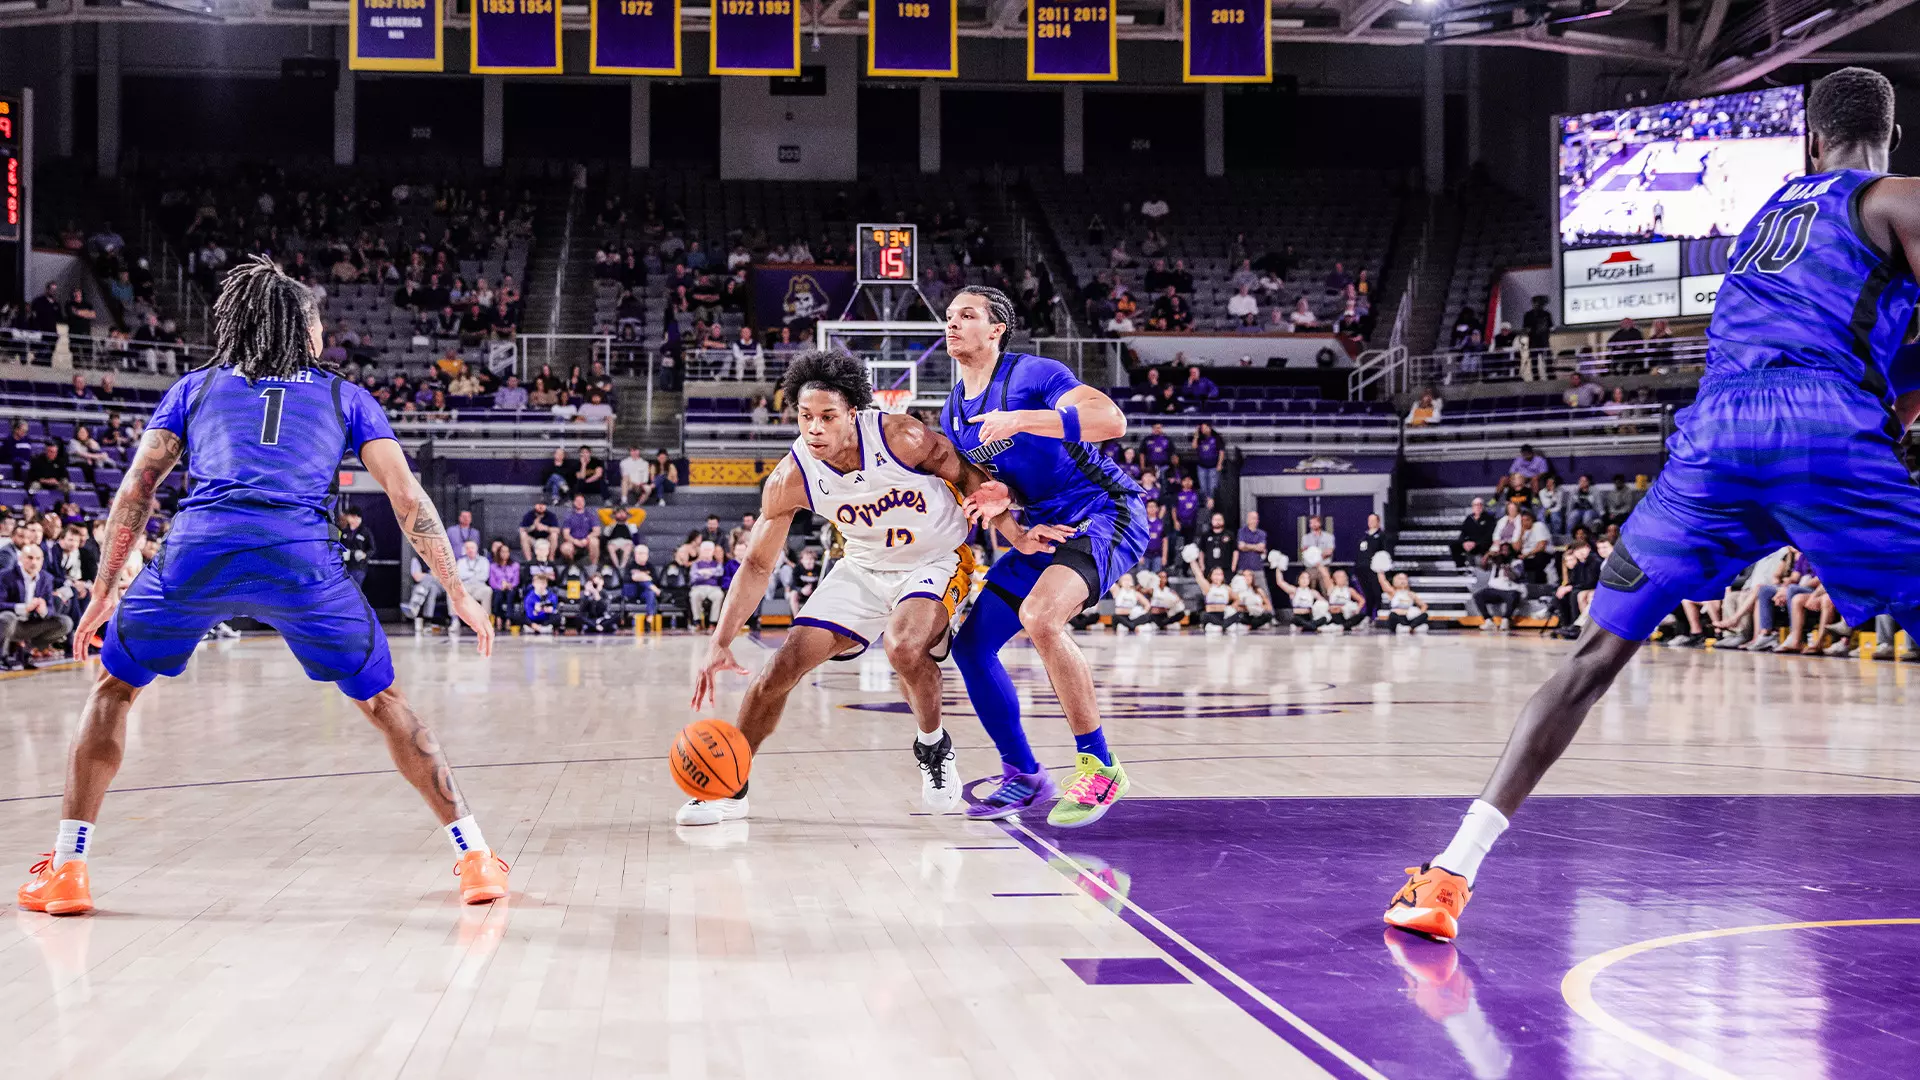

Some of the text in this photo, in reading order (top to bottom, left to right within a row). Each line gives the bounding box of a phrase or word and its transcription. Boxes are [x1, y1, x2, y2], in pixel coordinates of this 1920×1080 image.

[620, 1, 653, 16] 1972
[721, 1, 791, 16] 1972 1993
[898, 2, 930, 18] 1993
[1038, 6, 1107, 22] 2011 2013
[1211, 9, 1245, 24] 2013
[1038, 23, 1071, 38] 2014
[1730, 201, 1820, 274] 10
[879, 247, 905, 278] 15
[1587, 263, 1655, 281] Pizza Hut
[1618, 292, 1676, 309] HEALTH
[259, 387, 286, 445] 1
[818, 479, 830, 495] C
[836, 487, 927, 528] Pirates
